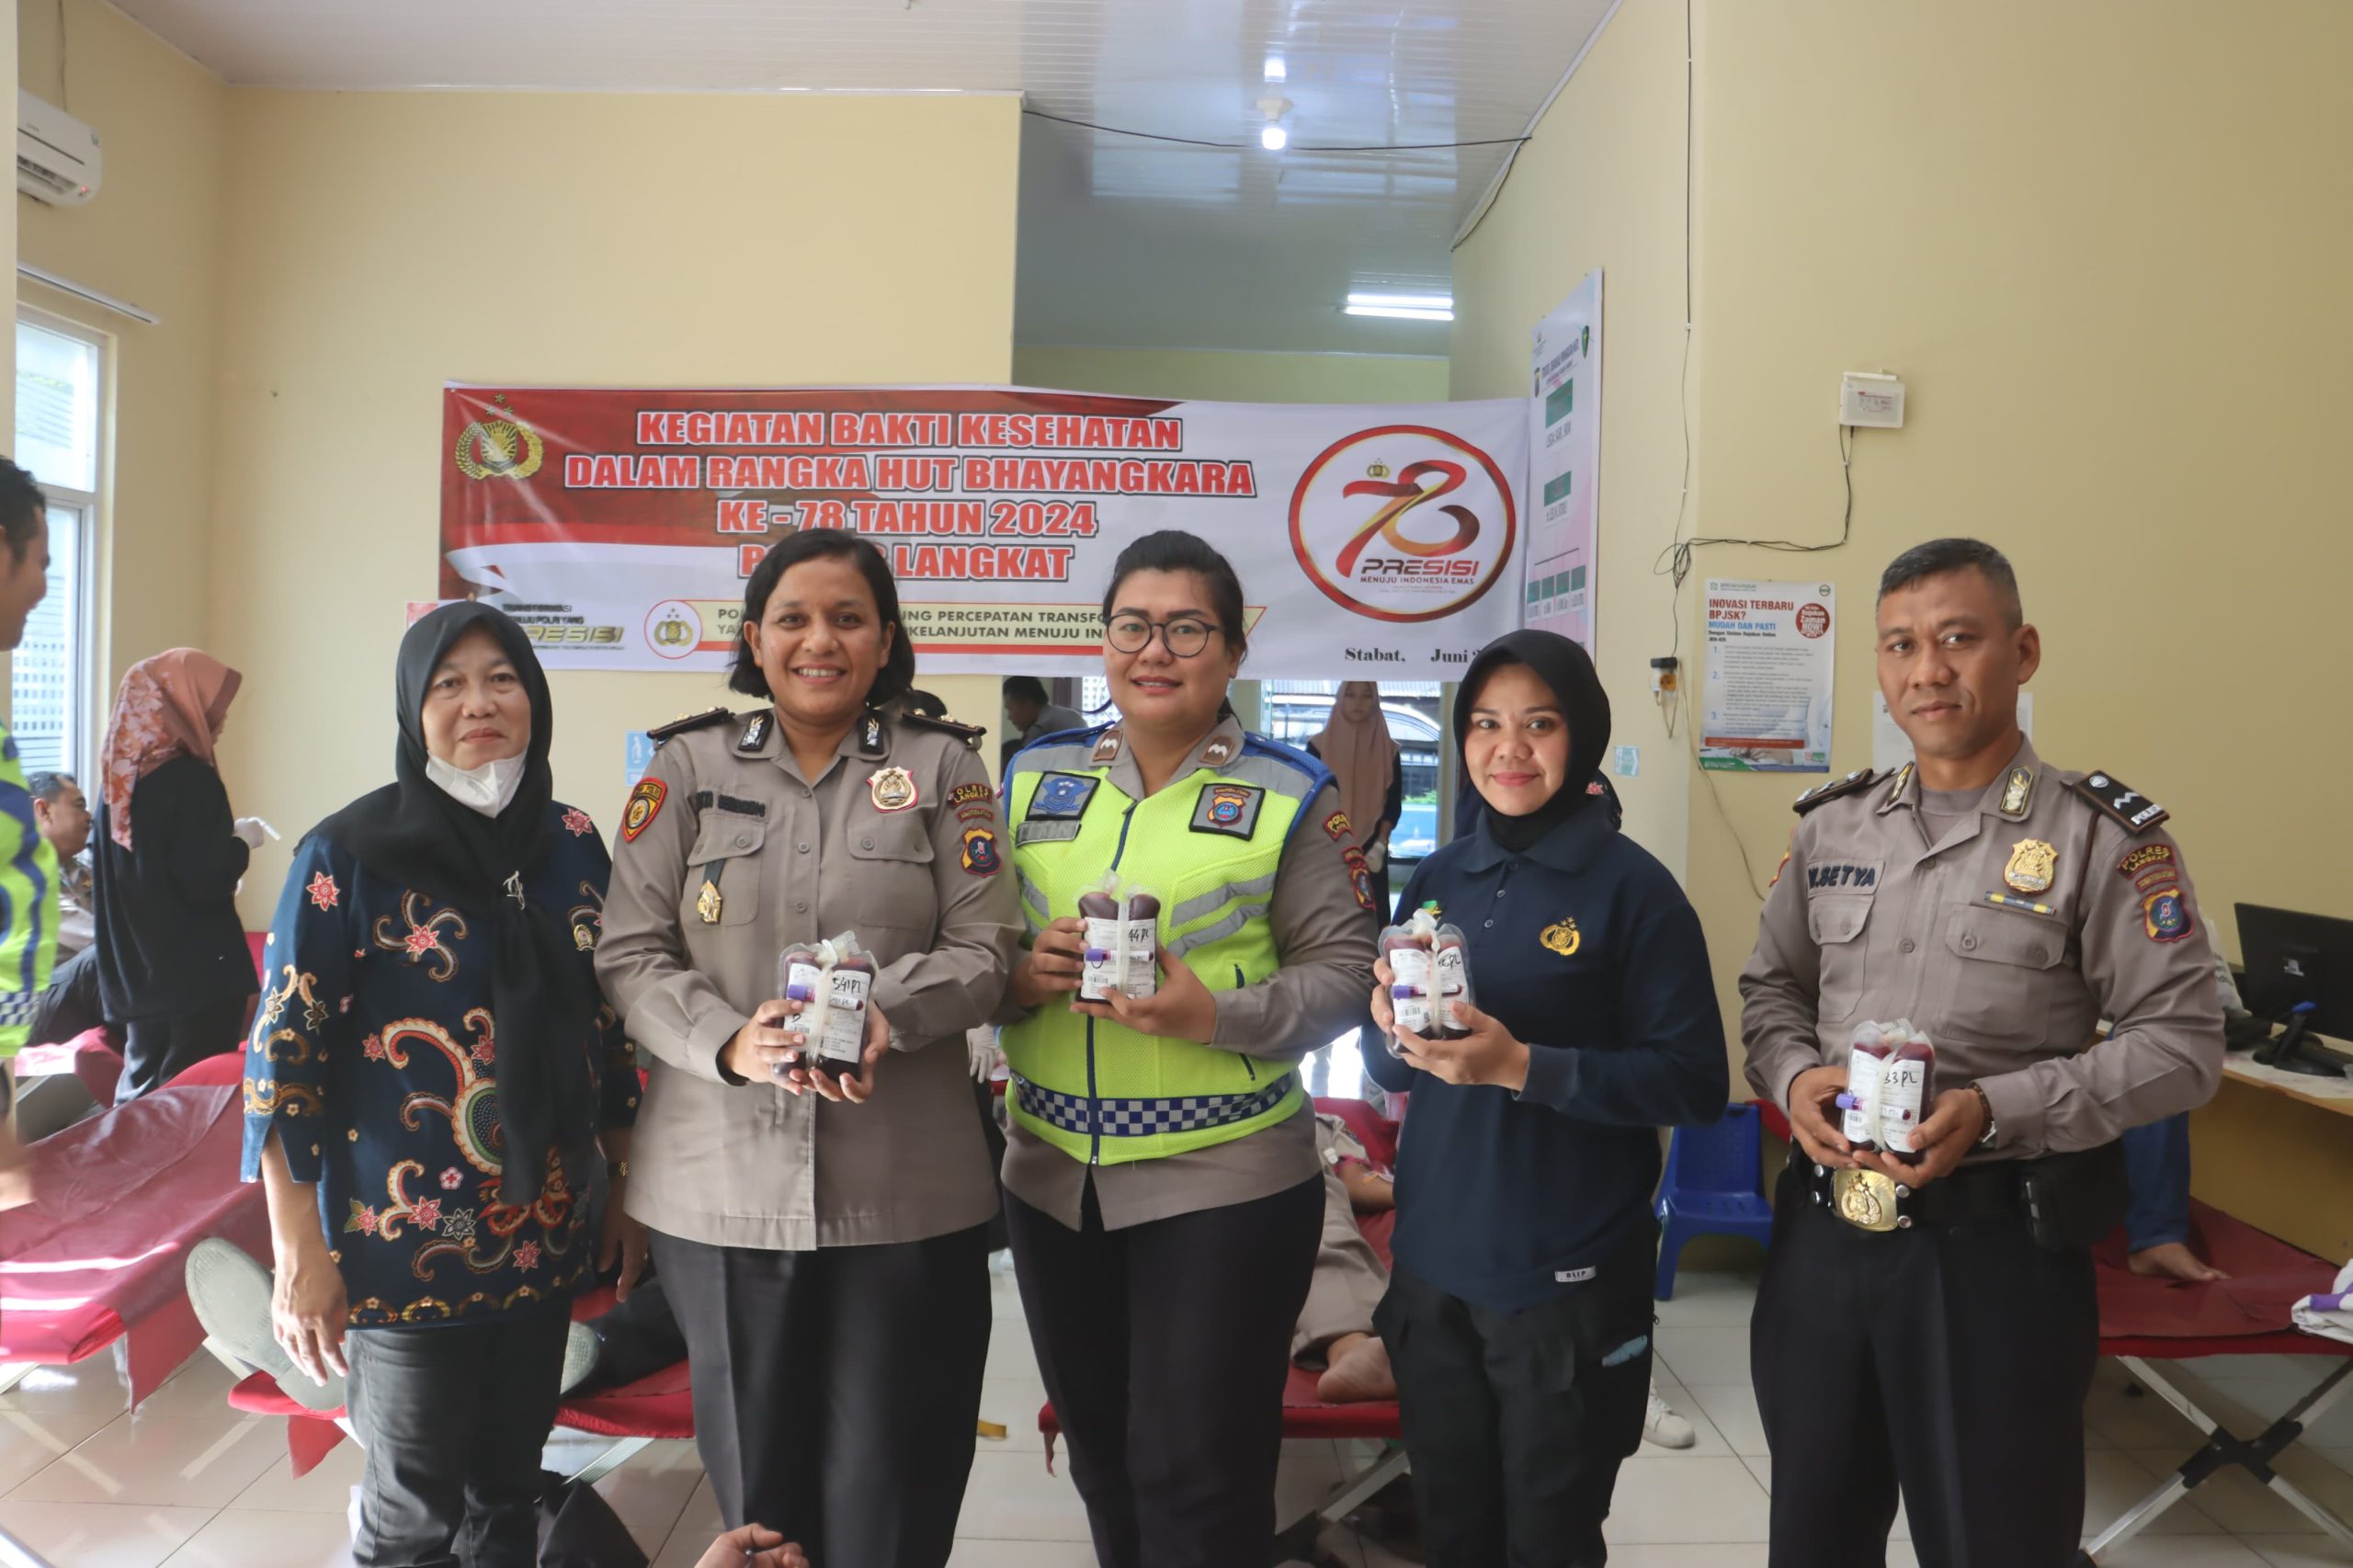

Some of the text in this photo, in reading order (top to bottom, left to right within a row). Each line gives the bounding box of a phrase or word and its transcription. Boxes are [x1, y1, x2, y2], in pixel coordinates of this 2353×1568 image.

[636, 411, 1181, 450] KEGIATAN BAKTI KESEHATAN
[564, 455, 1256, 496] DALAM RANGKA HUT BHAYANGKARA
[717, 499, 768, 534] KE
[794, 500, 846, 531] 78
[851, 501, 985, 535] TAHUN
[989, 502, 1097, 536] 2024
[892, 544, 1074, 581] LANGKAT
[1360, 558, 1480, 576] PRESISI
[1709, 598, 1747, 609] INOVASI
[1750, 600, 1794, 611] TERBARU
[938, 610, 1033, 622] PERCEPATAN
[1040, 612, 1103, 623] TRANSFO
[1709, 610, 1746, 620] BPJSK?
[523, 626, 624, 643] RESISI
[905, 626, 1009, 637] KELANJUTAN
[1014, 627, 1080, 639] MENUJU
[1345, 648, 1406, 664] Stabat,
[1430, 649, 1468, 663] Juni
[2121, 846, 2170, 869] POLRES
